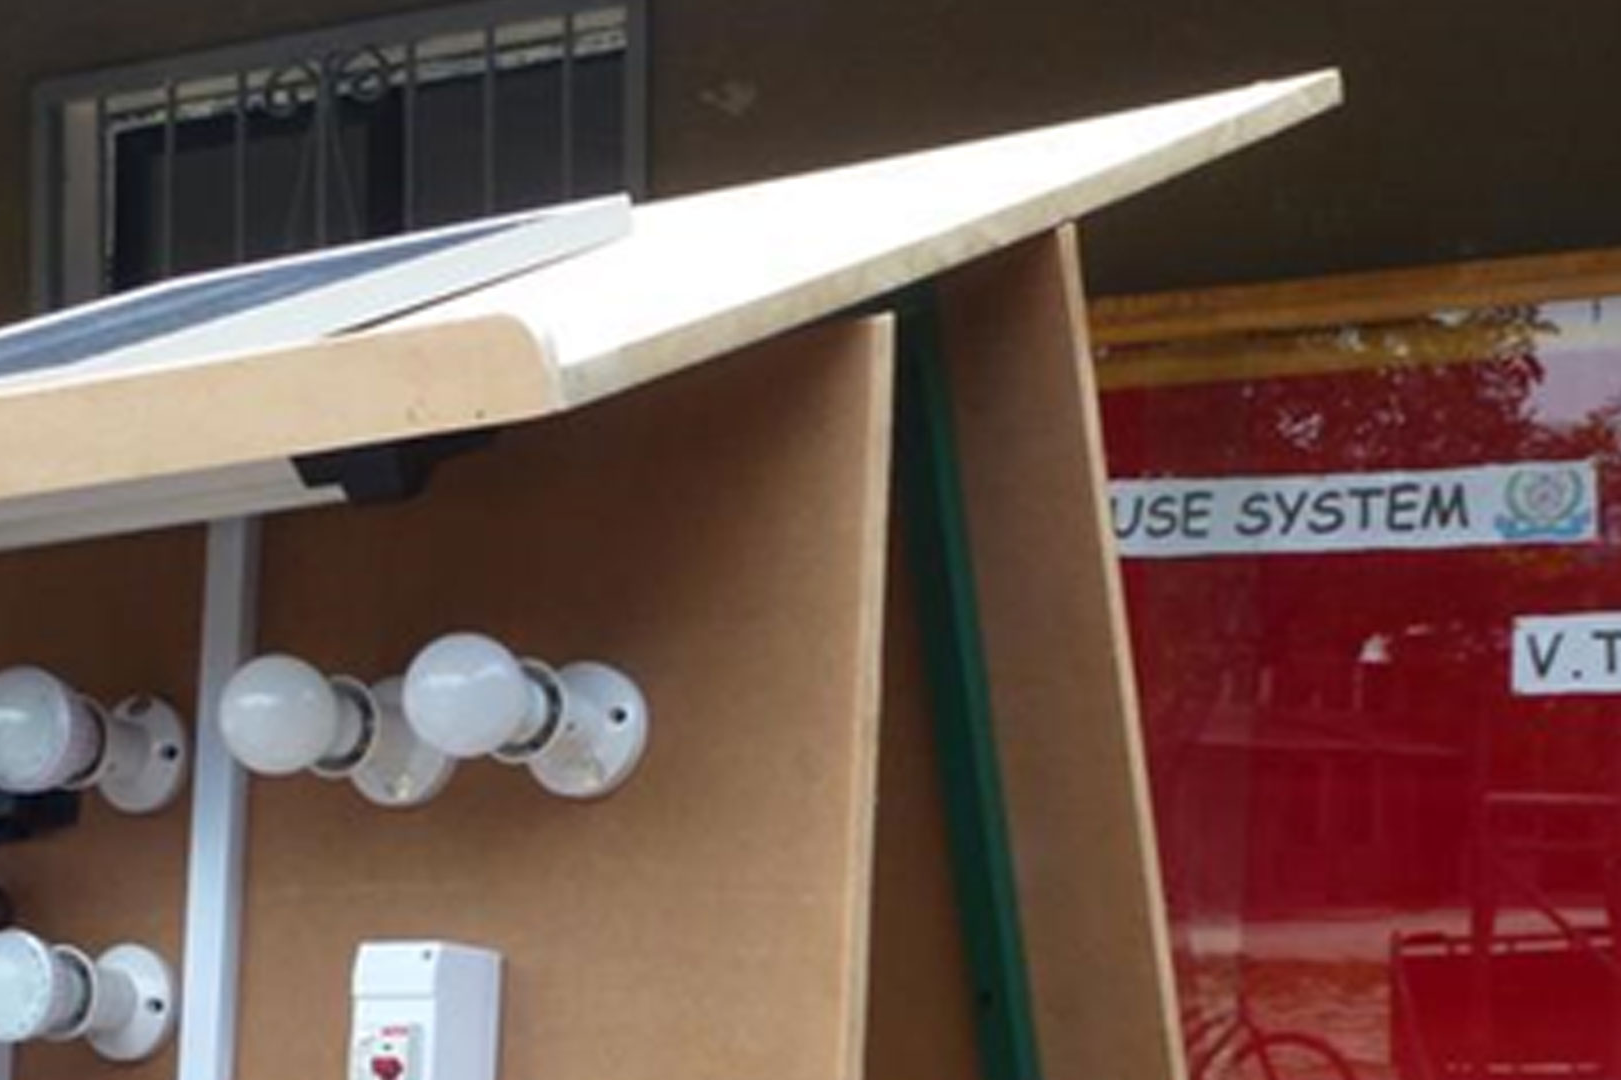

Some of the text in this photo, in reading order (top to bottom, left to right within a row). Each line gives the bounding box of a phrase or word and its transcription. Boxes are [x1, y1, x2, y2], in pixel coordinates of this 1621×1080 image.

[1110, 483, 1470, 540] USE SYSTEM
[1526, 629, 1621, 680] V.T
